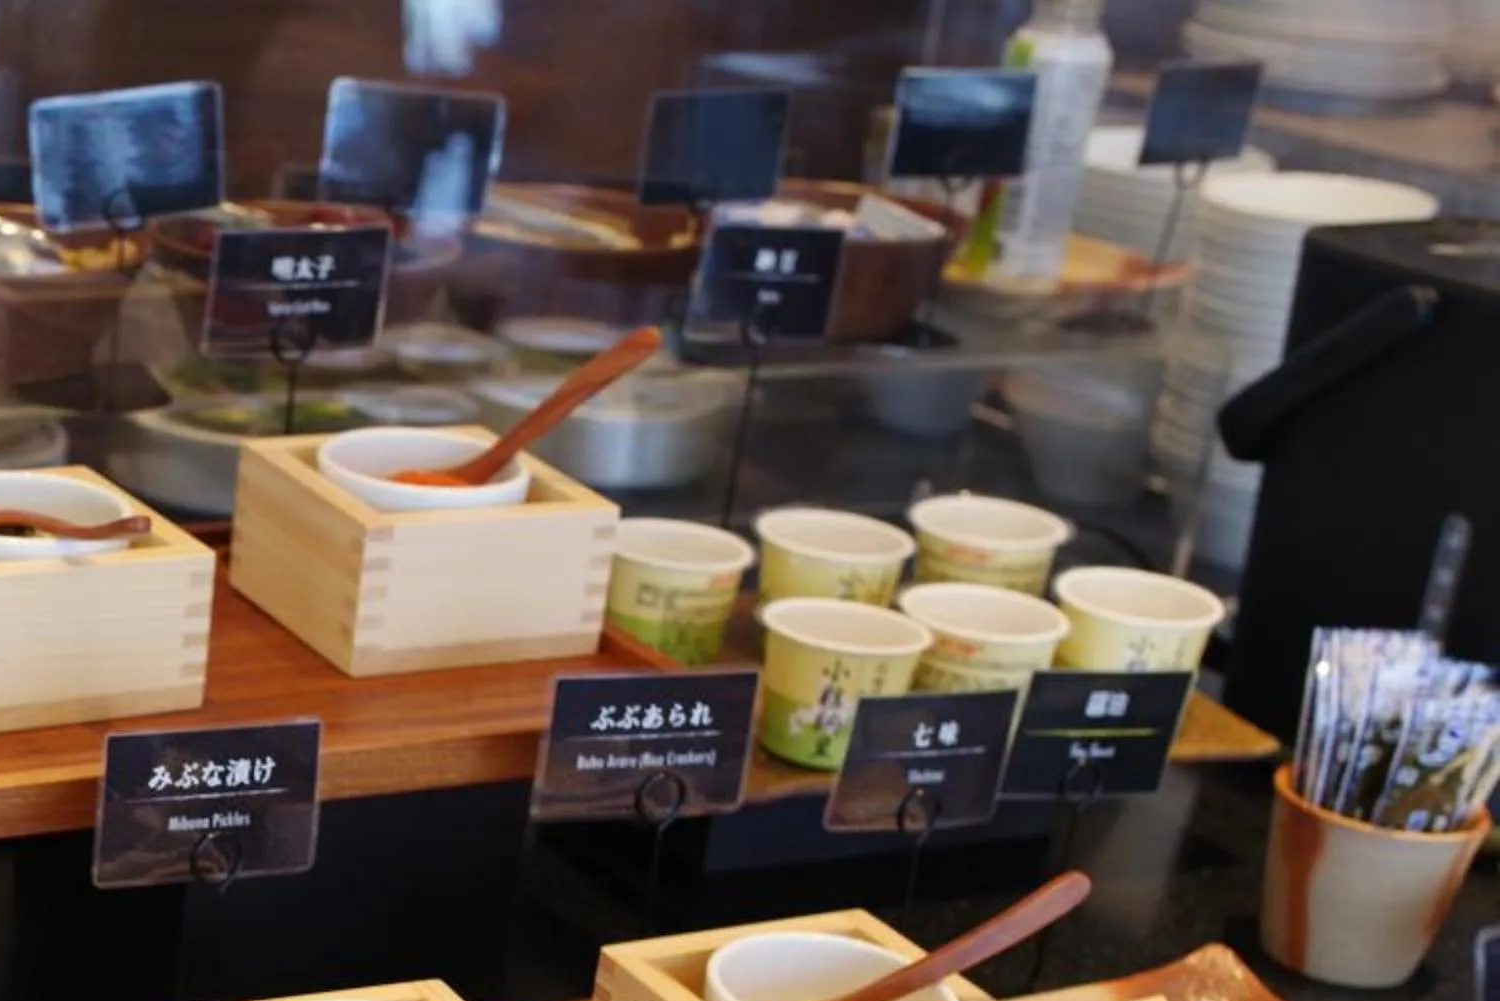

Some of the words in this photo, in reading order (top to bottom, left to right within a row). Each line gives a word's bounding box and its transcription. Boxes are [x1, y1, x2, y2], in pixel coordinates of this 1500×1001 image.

[590, 701, 714, 731] ぶぶあられ
[148, 756, 277, 791] みぶな漬け
[212, 811, 251, 828] Pickles
